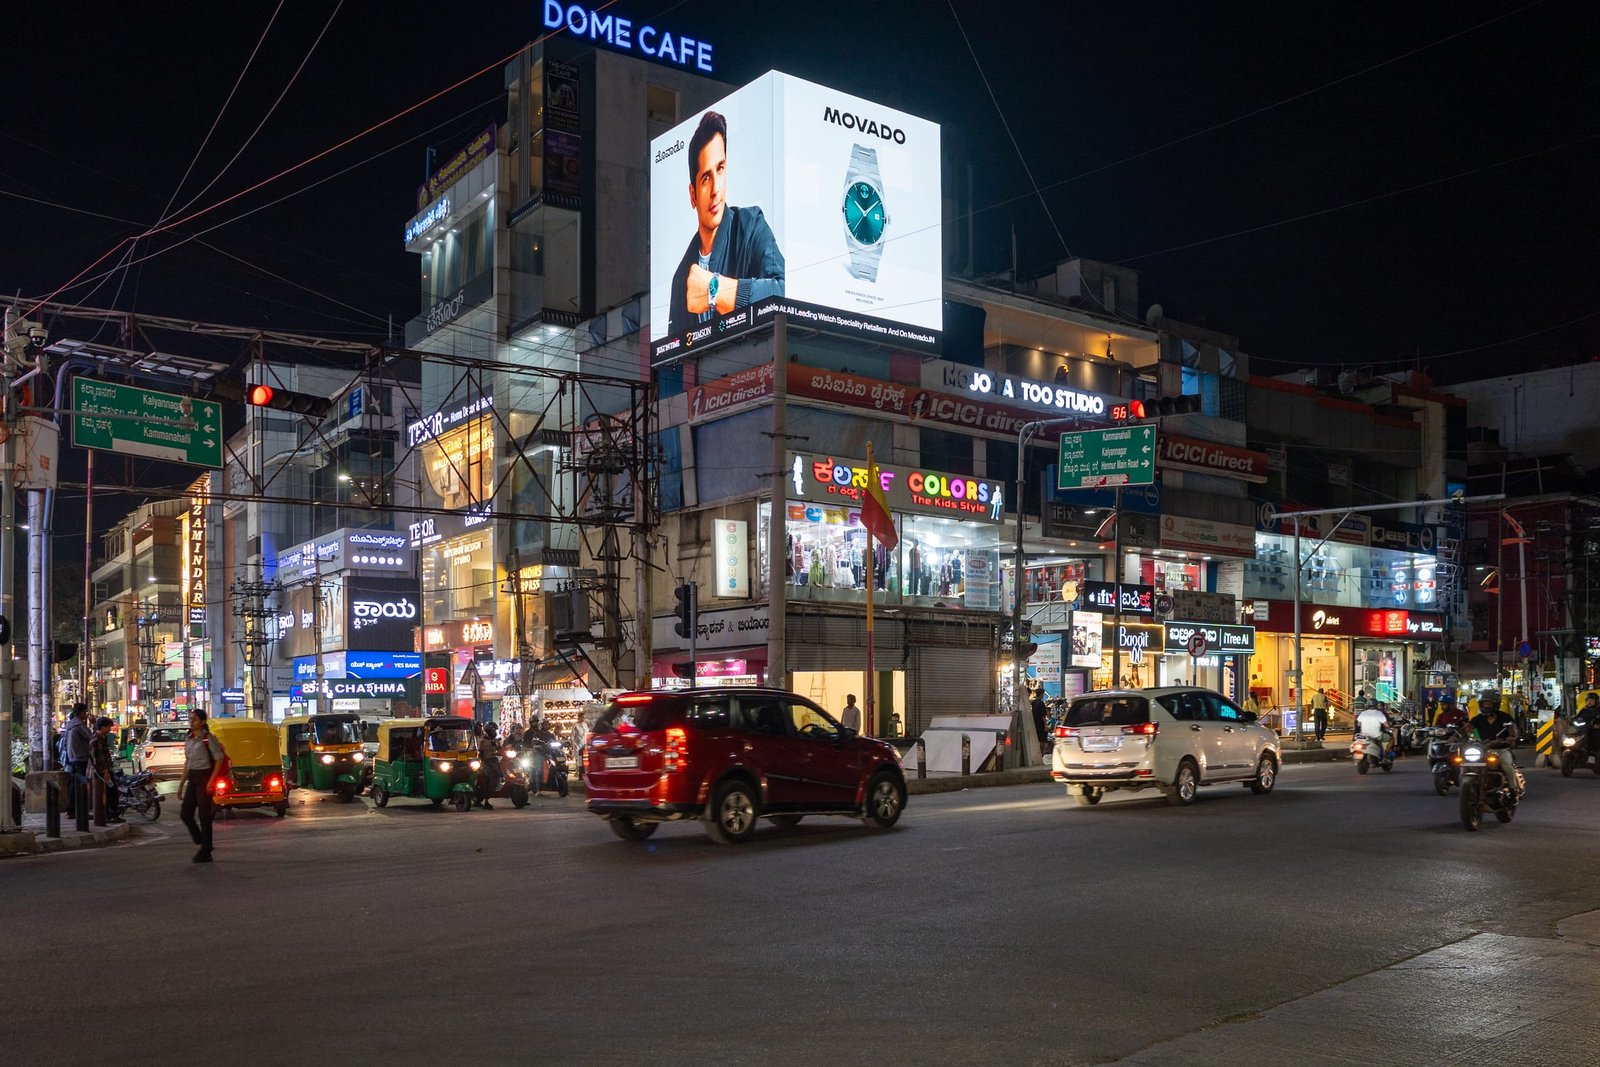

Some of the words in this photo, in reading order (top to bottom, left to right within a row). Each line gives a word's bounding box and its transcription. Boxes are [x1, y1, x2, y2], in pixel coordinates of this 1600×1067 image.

[543, 0, 632, 49] DOME
[638, 26, 713, 72] CAFE
[823, 106, 907, 145] MOVADO
[757, 303, 779, 317] Available
[779, 303, 787, 314] At
[787, 305, 795, 315] All
[795, 307, 818, 321] Leading
[818, 311, 837, 324] Watch
[836, 316, 864, 330] Speciality
[863, 320, 888, 334] Retailers
[887, 327, 900, 337] And
[899, 328, 908, 338] On
[705, 391, 732, 411] ICICI
[732, 382, 767, 403] direct
[1054, 388, 1104, 414] STUDIO
[929, 397, 985, 427] ICICI
[1112, 406, 1128, 420] 96
[143, 427, 192, 445] Kammanahalli
[1102, 429, 1132, 441] Kammanahalli
[1101, 447, 1128, 459] Kalyannagar
[1101, 460, 1117, 471] Hennur
[1116, 459, 1127, 470] Main
[1127, 458, 1140, 469] Road
[1166, 441, 1207, 464] ICICI
[1207, 449, 1254, 472] direct
[907, 471, 990, 503] COLORS
[911, 493, 933, 507] The
[933, 497, 958, 510] Kids
[959, 500, 986, 514] Style
[409, 518, 435, 541] TEOR
[191, 505, 204, 603] ZAMINDAR
[727, 620, 735, 633] &
[1119, 625, 1149, 649] Baggit
[1223, 631, 1241, 645] iTree
[1241, 632, 1249, 645] Ai
[425, 682, 445, 691] BIBA
